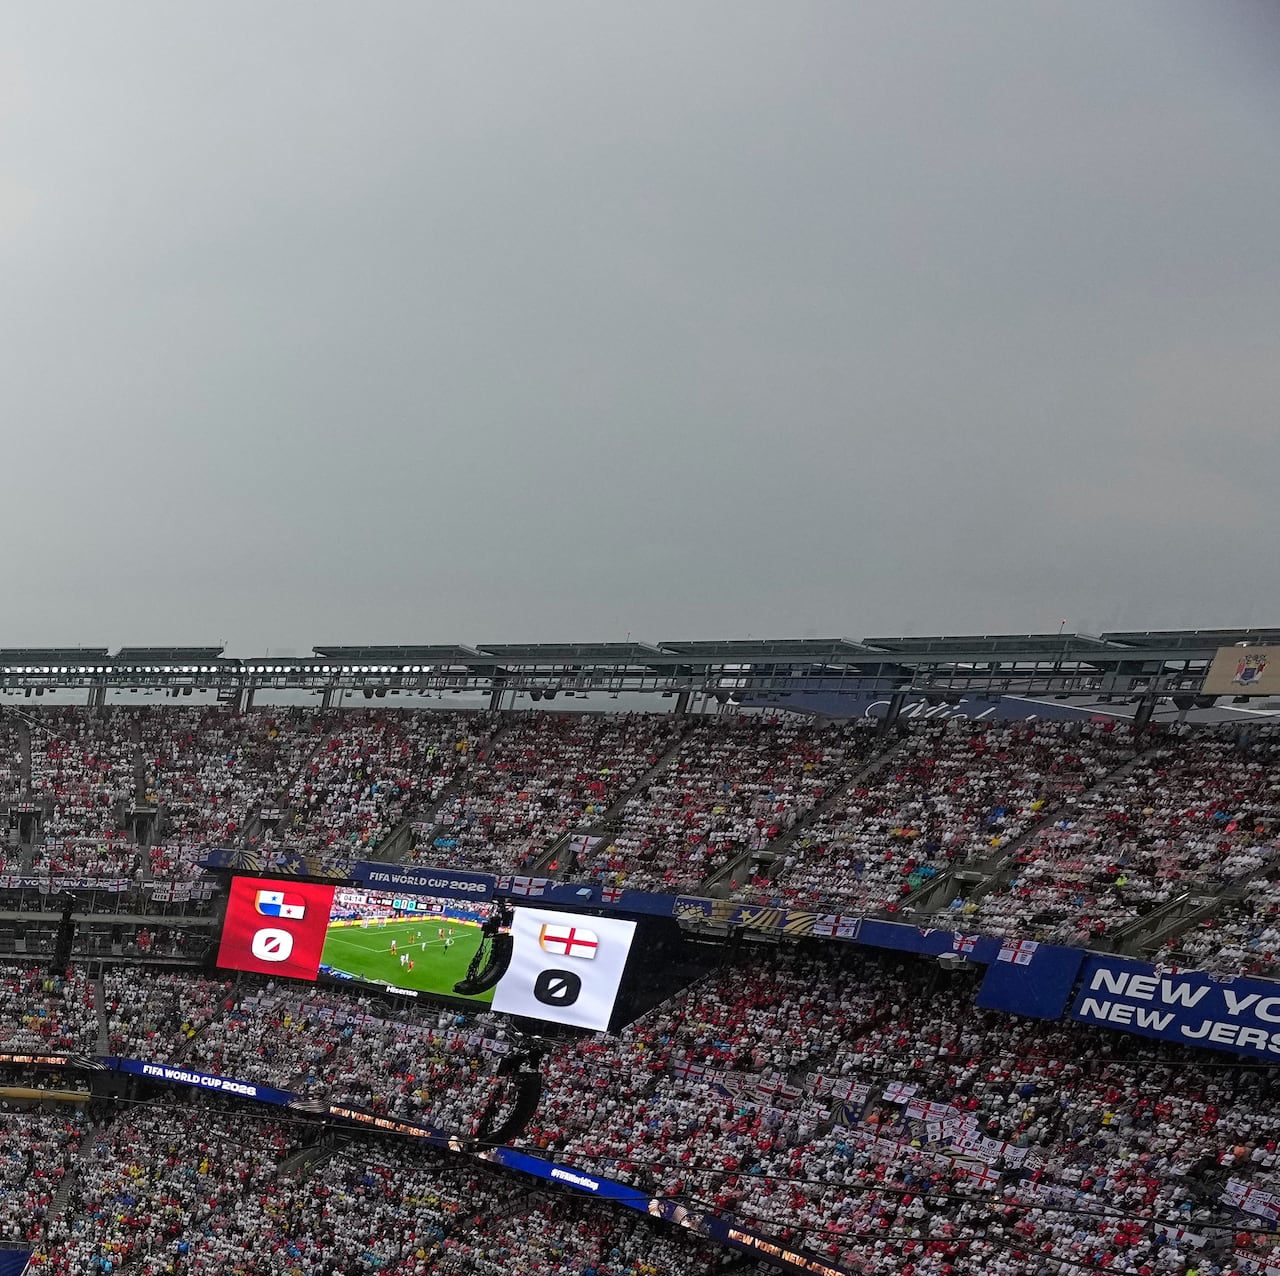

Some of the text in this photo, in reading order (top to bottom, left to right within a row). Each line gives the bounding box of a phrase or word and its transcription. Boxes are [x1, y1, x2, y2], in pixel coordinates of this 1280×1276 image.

[369, 872, 487, 893] FIFA WORLD CUP 2026
[386, 985, 419, 997] Hisense
[1090, 968, 1211, 1008] NEW
[1080, 998, 1176, 1032] NEW
[12, 1055, 33, 1063] NEW
[33, 1056, 68, 1065] JERSEY
[143, 1065, 257, 1096] FIFA WORLD CUP 2026
[330, 1106, 432, 1138] NEW YORK NEW JERSEY
[728, 1229, 754, 1246] NEW
[754, 1238, 782, 1257] YORK
[781, 1250, 808, 1268] NEW
